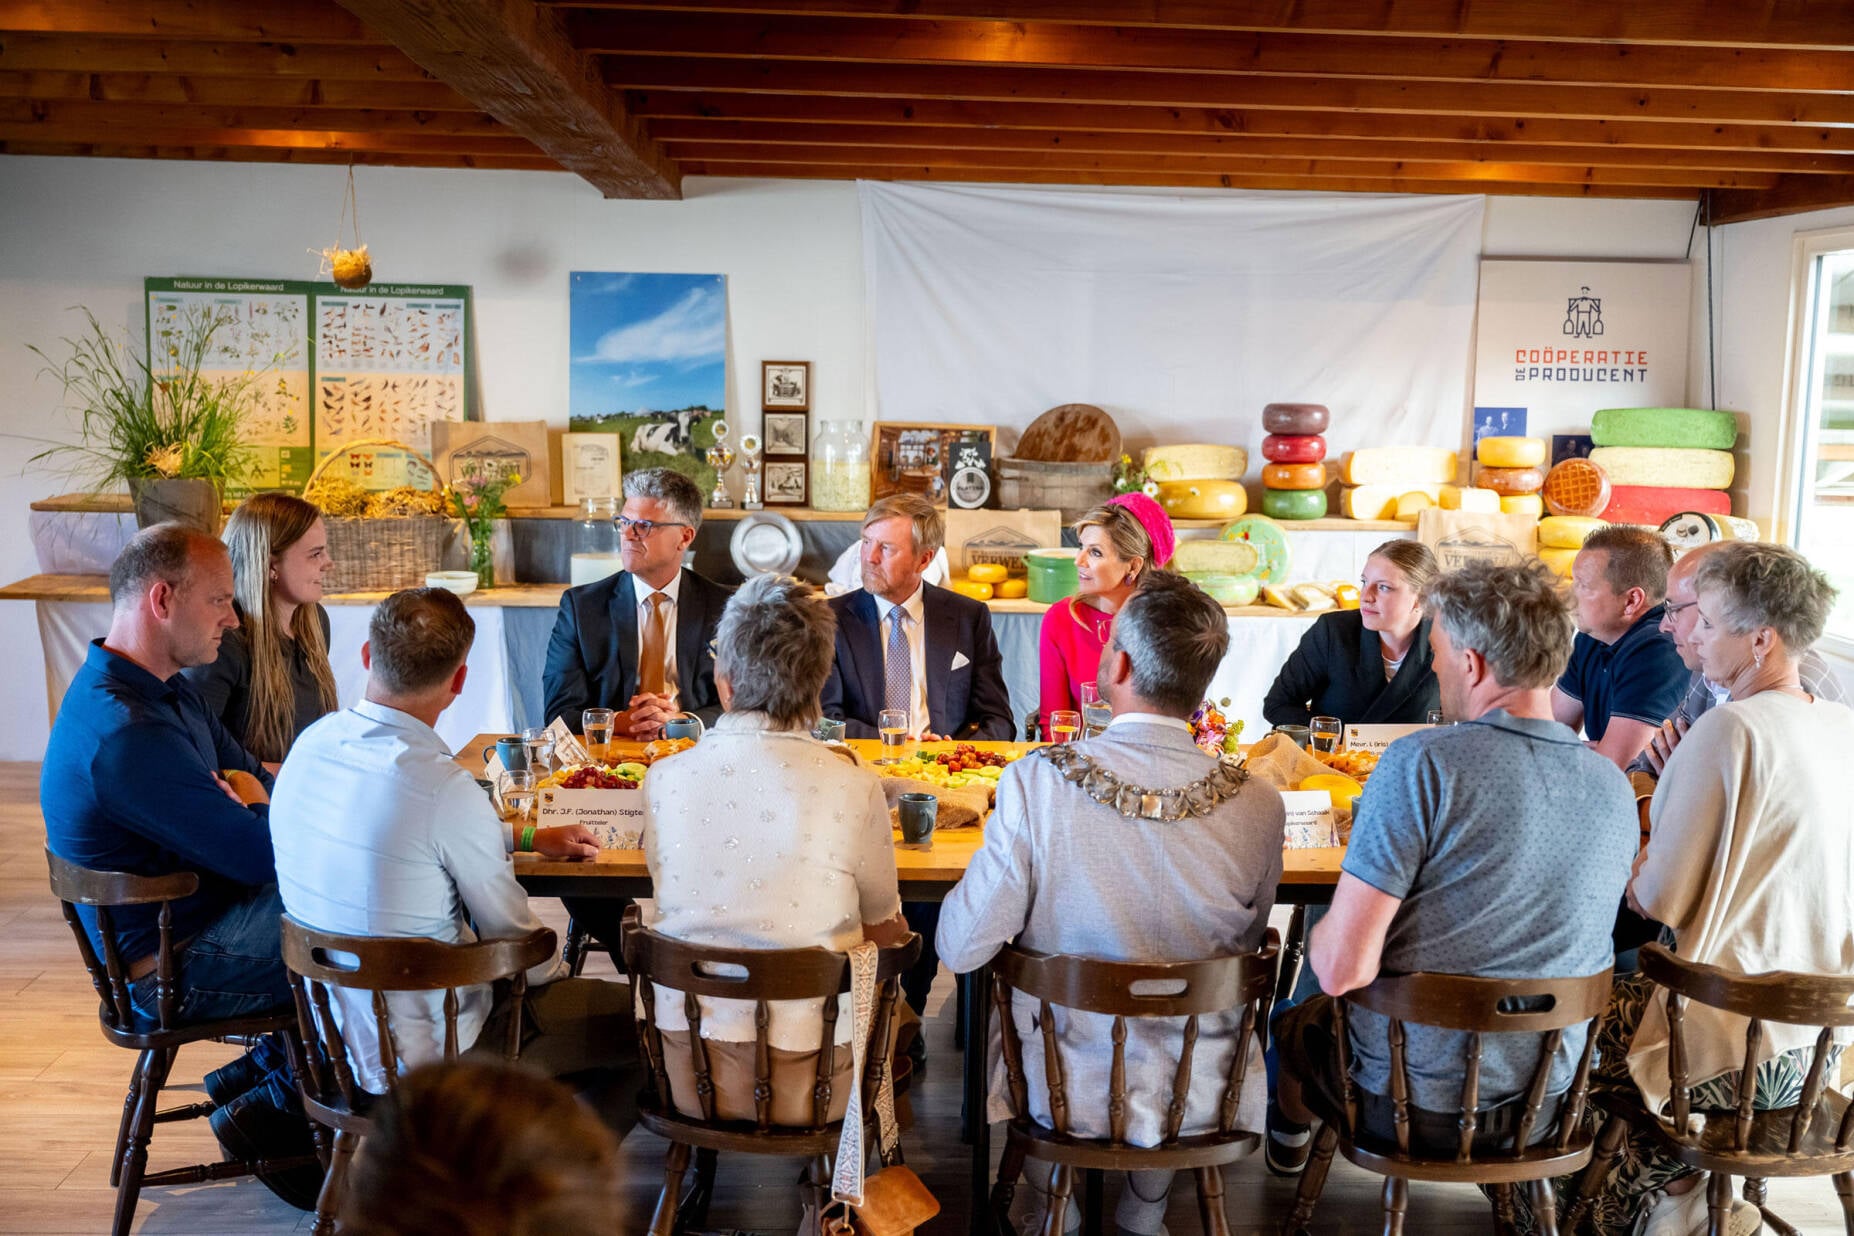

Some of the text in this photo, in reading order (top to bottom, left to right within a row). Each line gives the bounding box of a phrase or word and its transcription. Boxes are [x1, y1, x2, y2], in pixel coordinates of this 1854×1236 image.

[173, 280, 284, 292] Natuur in de Lopikerwaard
[369, 285, 377, 293] in
[378, 285, 389, 294] de
[390, 285, 444, 296] Lopikerwaard
[1515, 346, 1648, 365] COÖPERATIE
[1515, 367, 1648, 382] DE PRODUCENT
[971, 555, 1024, 569] VERWE
[575, 808, 618, 816] (Jonathan)
[619, 808, 644, 817] Stigte
